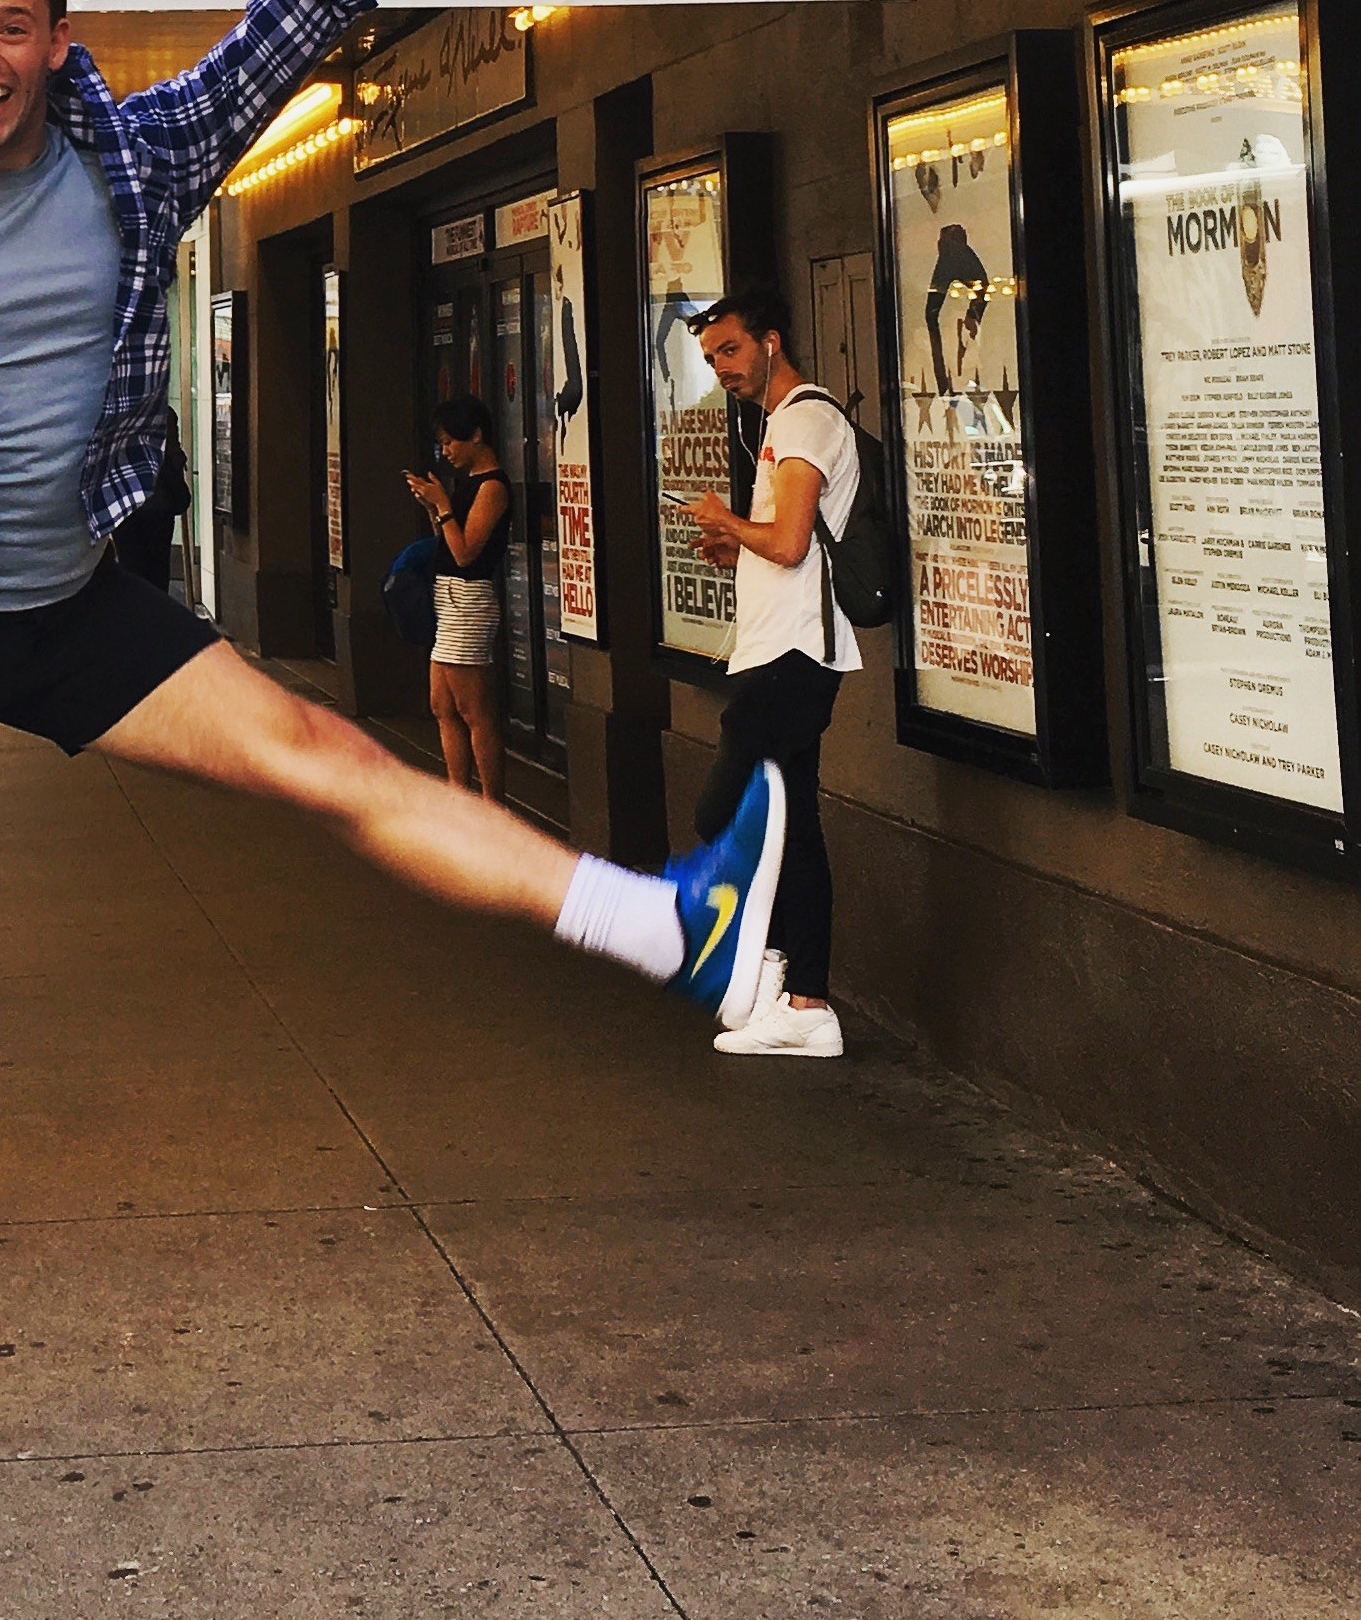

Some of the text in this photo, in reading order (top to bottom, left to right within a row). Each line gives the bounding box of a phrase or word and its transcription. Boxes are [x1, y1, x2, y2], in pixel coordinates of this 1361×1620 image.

[1166, 192, 1185, 212] THE
[1188, 186, 1219, 209] BOOK
[1229, 346, 1251, 359] LOPEZ
[1252, 346, 1267, 357] AND
[1268, 344, 1286, 356] MATT
[1287, 342, 1311, 355] STONE
[662, 436, 730, 478] SUCCESS
[559, 480, 589, 504] FOURTH
[941, 474, 961, 494] HAD
[963, 474, 978, 495] ME
[930, 496, 950, 511] BOOK
[950, 498, 960, 512] OF
[560, 505, 591, 548] TIME
[916, 514, 954, 539] MARCH
[956, 516, 982, 541] INTO
[563, 582, 594, 618] HELLO
[667, 574, 672, 611] I
[919, 564, 1029, 613] A PRICELESSLY
[920, 599, 1005, 638] ENTERTAINING
[1007, 613, 1031, 643] ACT
[921, 640, 978, 675] DESERVES
[1229, 678, 1256, 692] STEPHEN
[1229, 713, 1289, 734] CASEY NICHOLAW
[1203, 742, 1325, 779] CASEY NICHOLAW AND TREY PARKER
